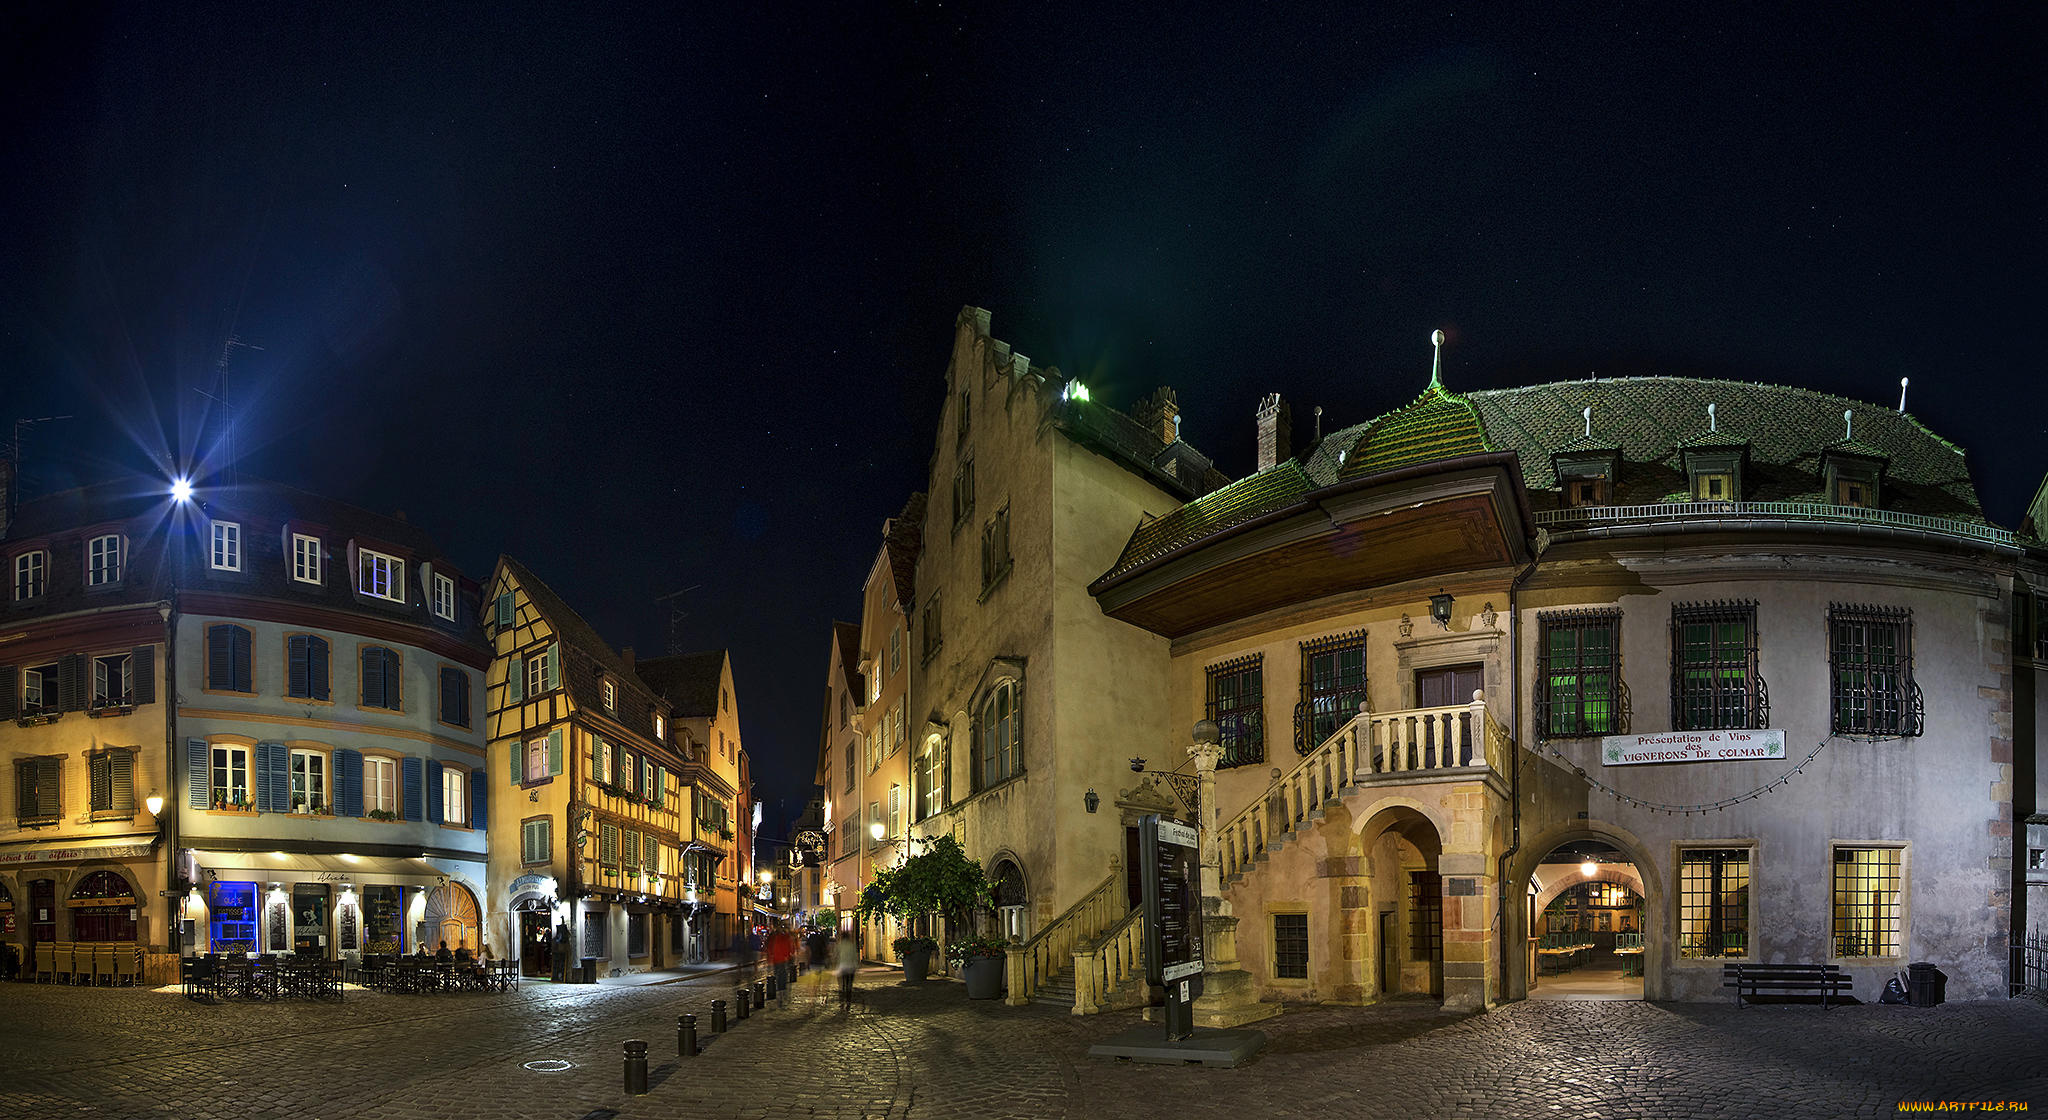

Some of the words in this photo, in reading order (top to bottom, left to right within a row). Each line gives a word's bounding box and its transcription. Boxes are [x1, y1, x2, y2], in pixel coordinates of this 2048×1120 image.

[1638, 734, 1702, 745] Présentation
[1708, 733, 1721, 742] de
[1728, 732, 1751, 742] Vins
[1685, 743, 1702, 751] des
[1624, 750, 1688, 762] VIGNERONS
[1696, 749, 1711, 758] DE
[1718, 748, 1765, 758] COLMAR
[48, 849, 78, 860] oifhus
